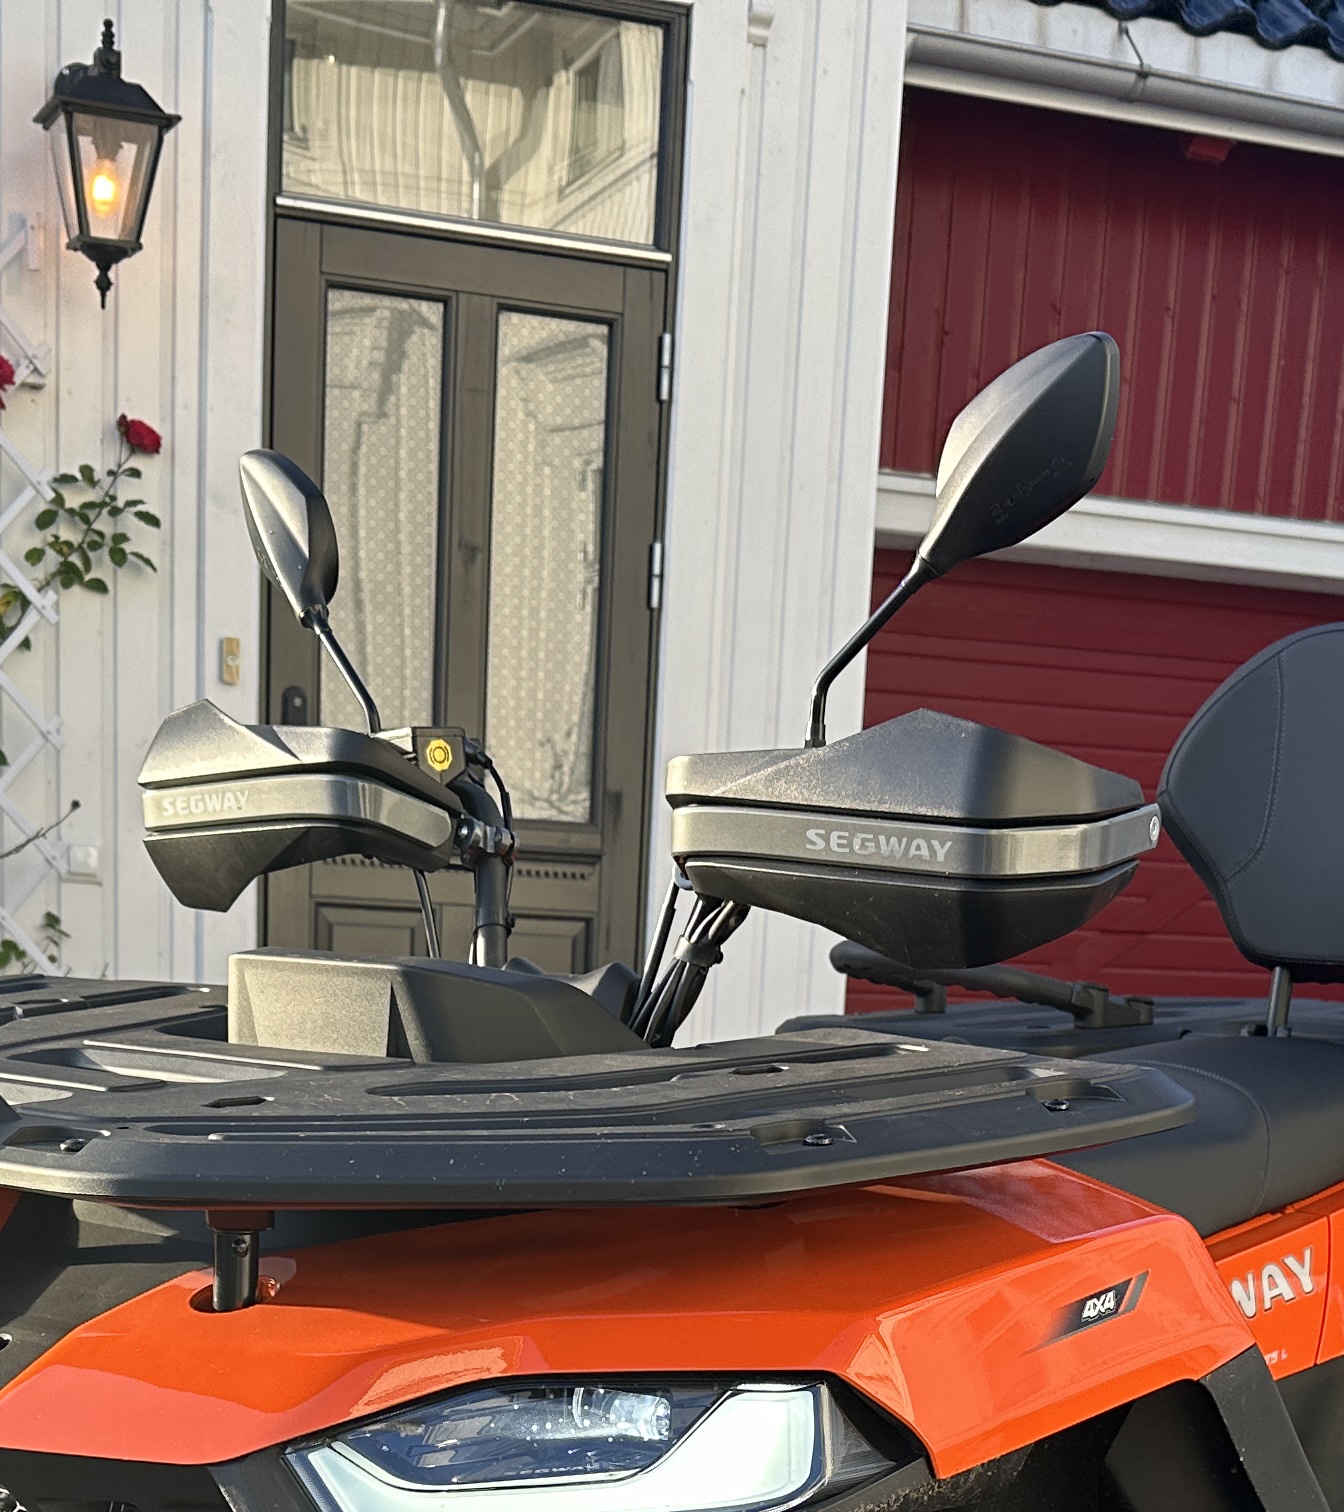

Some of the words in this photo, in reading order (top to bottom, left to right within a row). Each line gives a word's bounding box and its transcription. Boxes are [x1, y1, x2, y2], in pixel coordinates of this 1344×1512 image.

[161, 790, 249, 817] SEGWAY
[806, 828, 953, 863] SEGWAY
[1231, 1245, 1314, 1319] WAY
